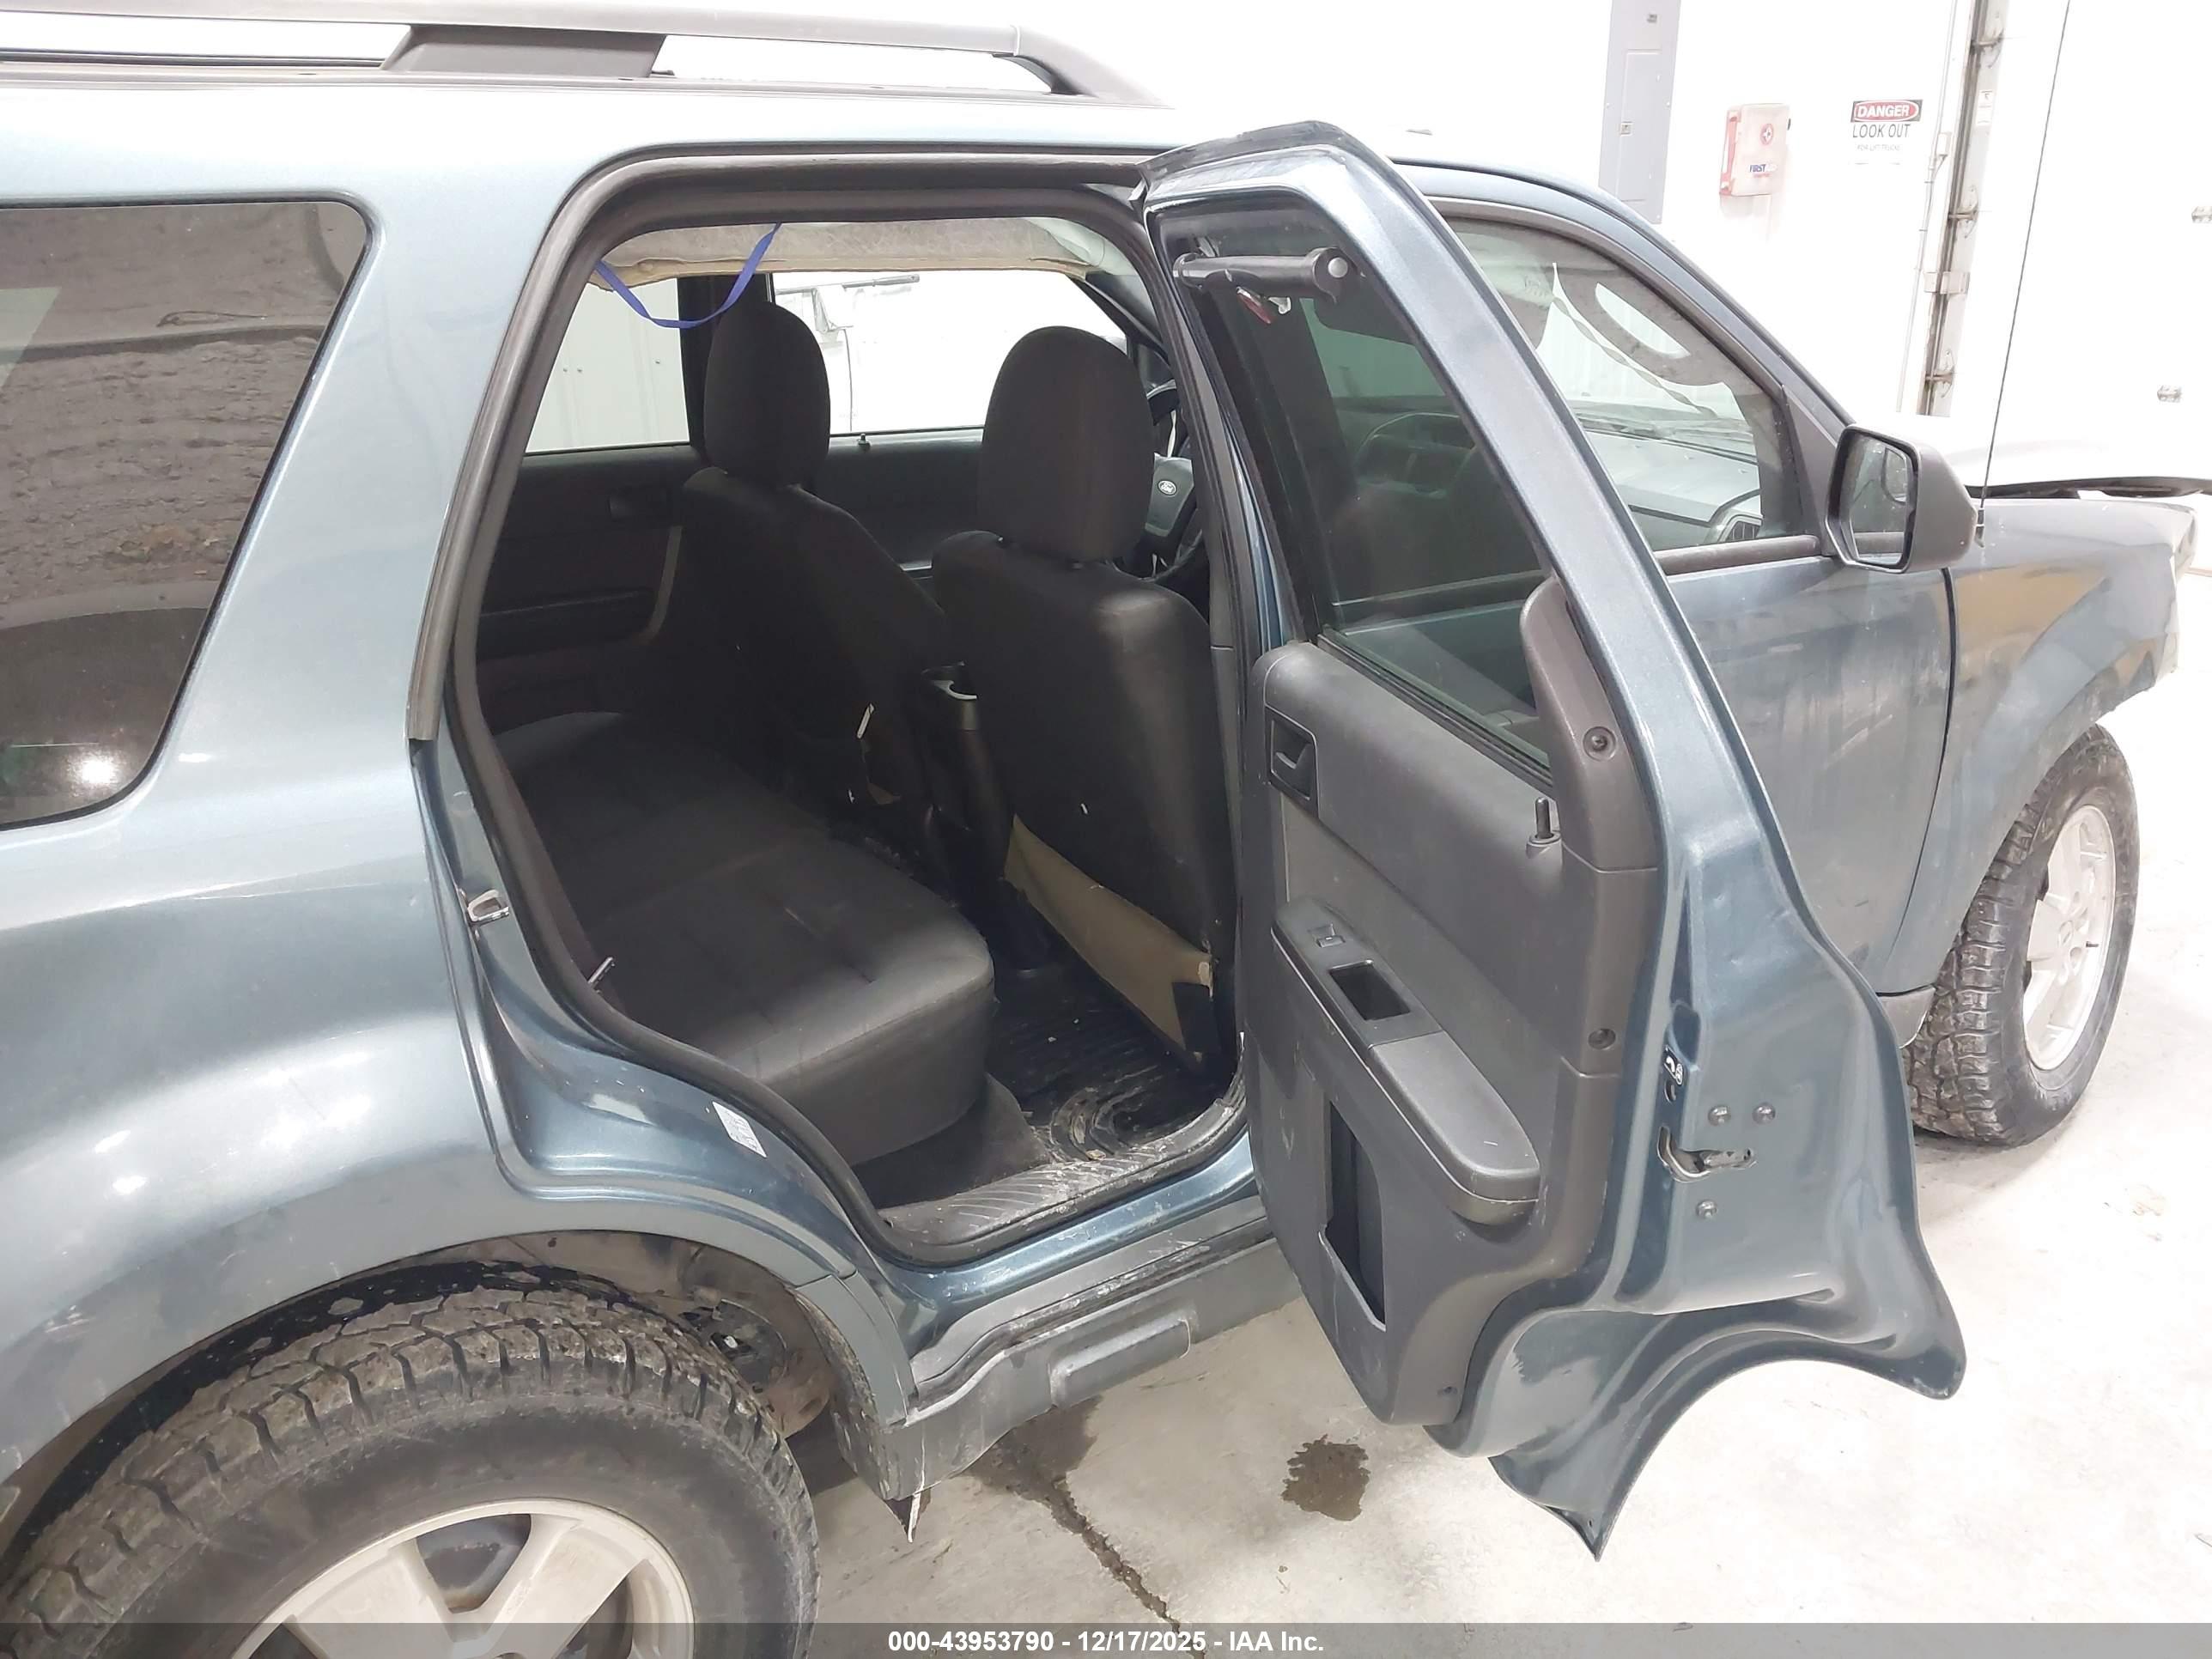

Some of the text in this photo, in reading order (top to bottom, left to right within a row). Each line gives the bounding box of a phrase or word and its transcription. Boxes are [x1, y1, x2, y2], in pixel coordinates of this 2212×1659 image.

[1857, 105, 1910, 118] DANGER
[1852, 124, 1911, 138] LOOK OUT
[1749, 163, 1766, 173] FIRST
